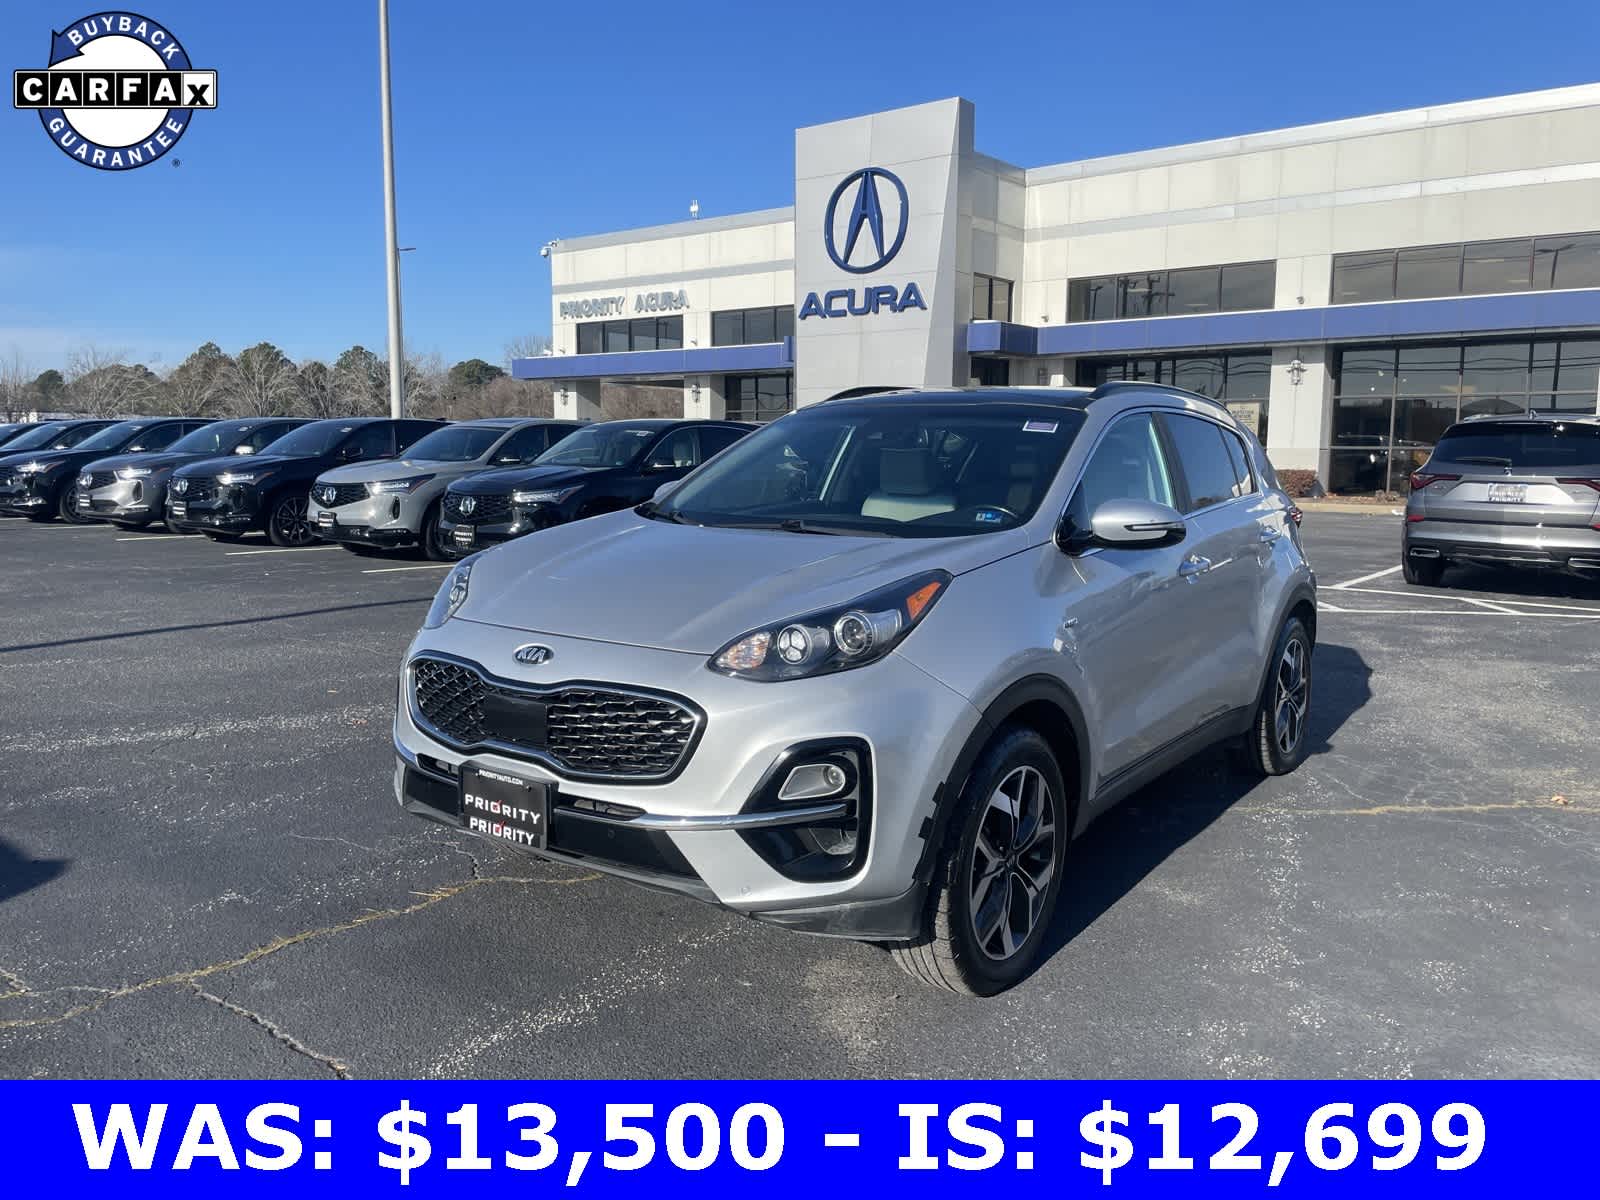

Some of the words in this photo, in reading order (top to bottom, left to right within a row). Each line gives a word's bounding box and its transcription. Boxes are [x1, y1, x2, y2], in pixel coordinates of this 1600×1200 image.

[560, 296, 625, 320] PRIORITY
[635, 289, 690, 313] ACURA
[799, 282, 928, 320] ACURA
[516, 647, 546, 663] KIA
[465, 793, 541, 825] PRIORITY
[470, 816, 535, 846] PRIORITY
